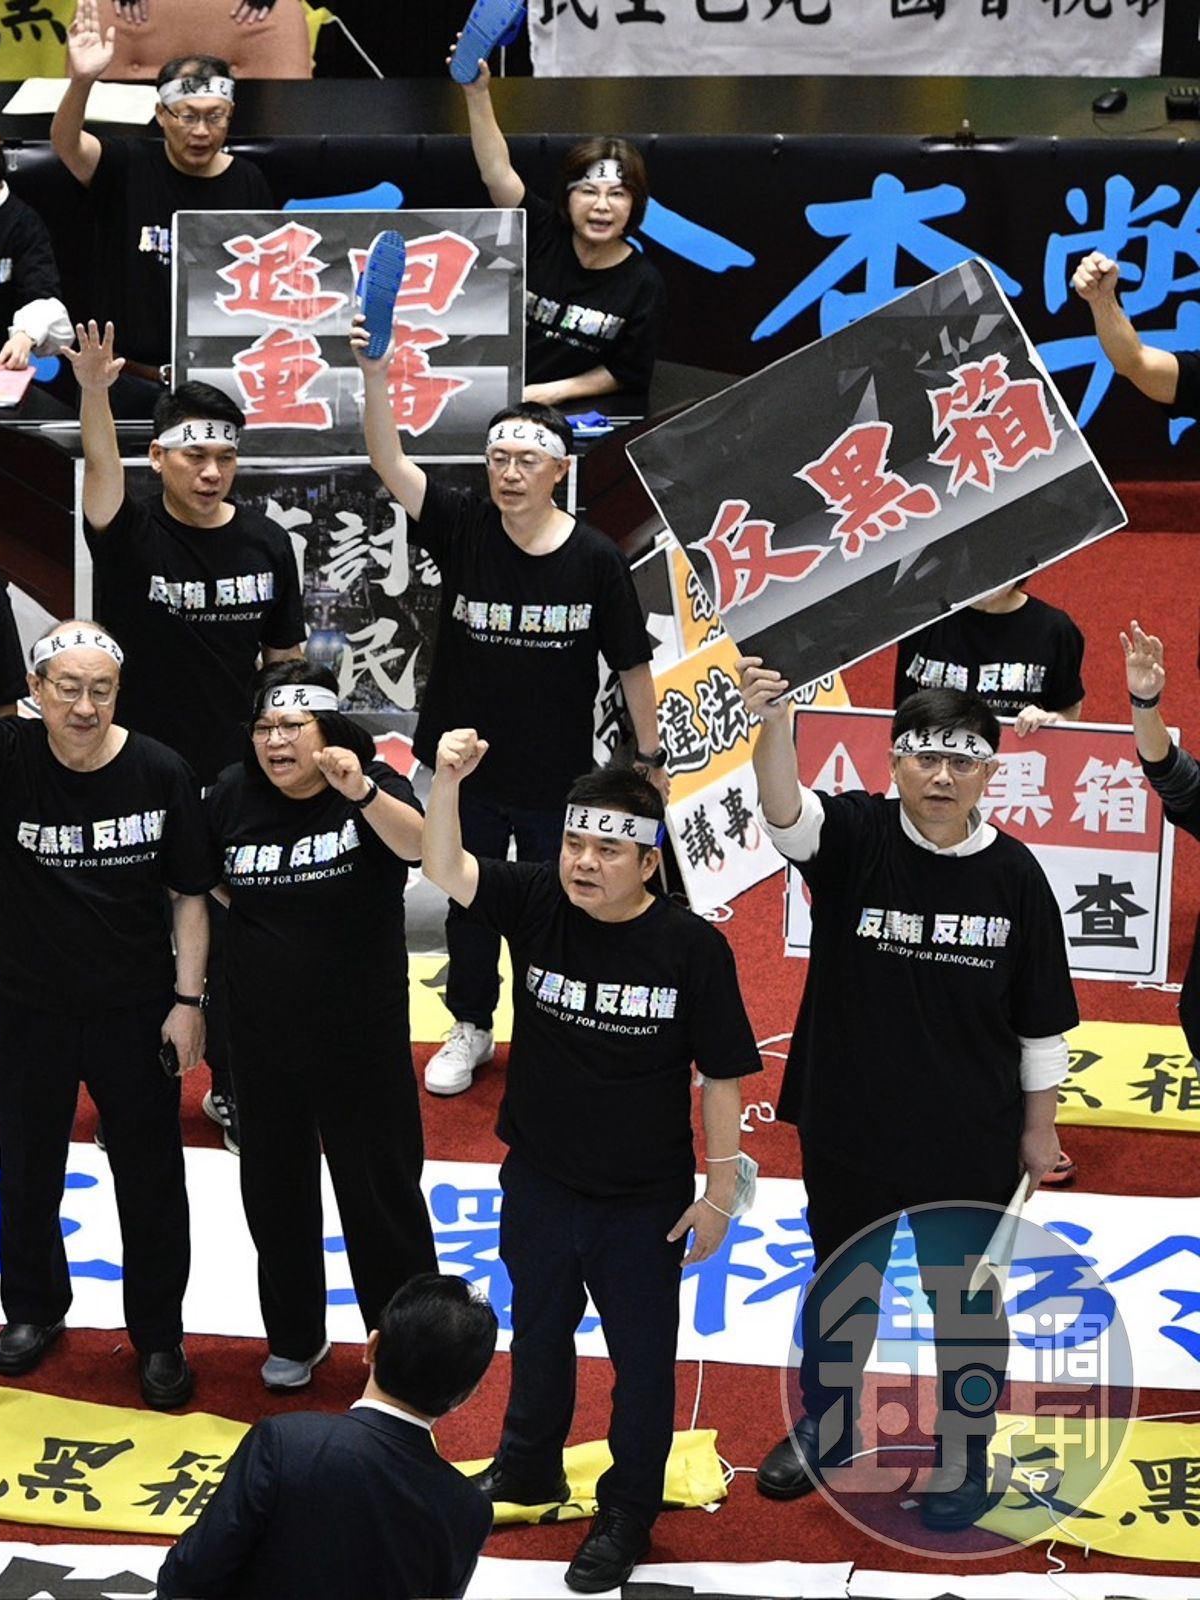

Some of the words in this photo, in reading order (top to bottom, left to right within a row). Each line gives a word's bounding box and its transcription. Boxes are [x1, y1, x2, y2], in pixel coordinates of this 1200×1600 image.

[688, 352, 1063, 614] 反黑箱
[519, 603, 593, 633] 反擴權
[17, 821, 84, 855] 反黑箱
[92, 809, 167, 851] 反擴權
[566, 806, 638, 838] 民主已死
[680, 787, 754, 870] 議事
[64, 857, 77, 868] UP
[80, 857, 99, 868] FOR
[101, 851, 158, 867] DEMOCRACY
[289, 819, 361, 869] 反擴權
[257, 875, 270, 886] UP
[273, 874, 292, 885] FOR
[294, 862, 354, 883] DEMOCRACY
[856, 907, 925, 944] 反黑箱
[931, 914, 1011, 948] 反擴權
[935, 951, 996, 970] DEMOCRACY
[526, 964, 587, 1012] 反黑箱
[595, 982, 677, 1020] 反擴權
[560, 1011, 574, 1023] UP
[576, 1013, 596, 1028] FOR
[597, 1021, 660, 1035] DEMOCRACY
